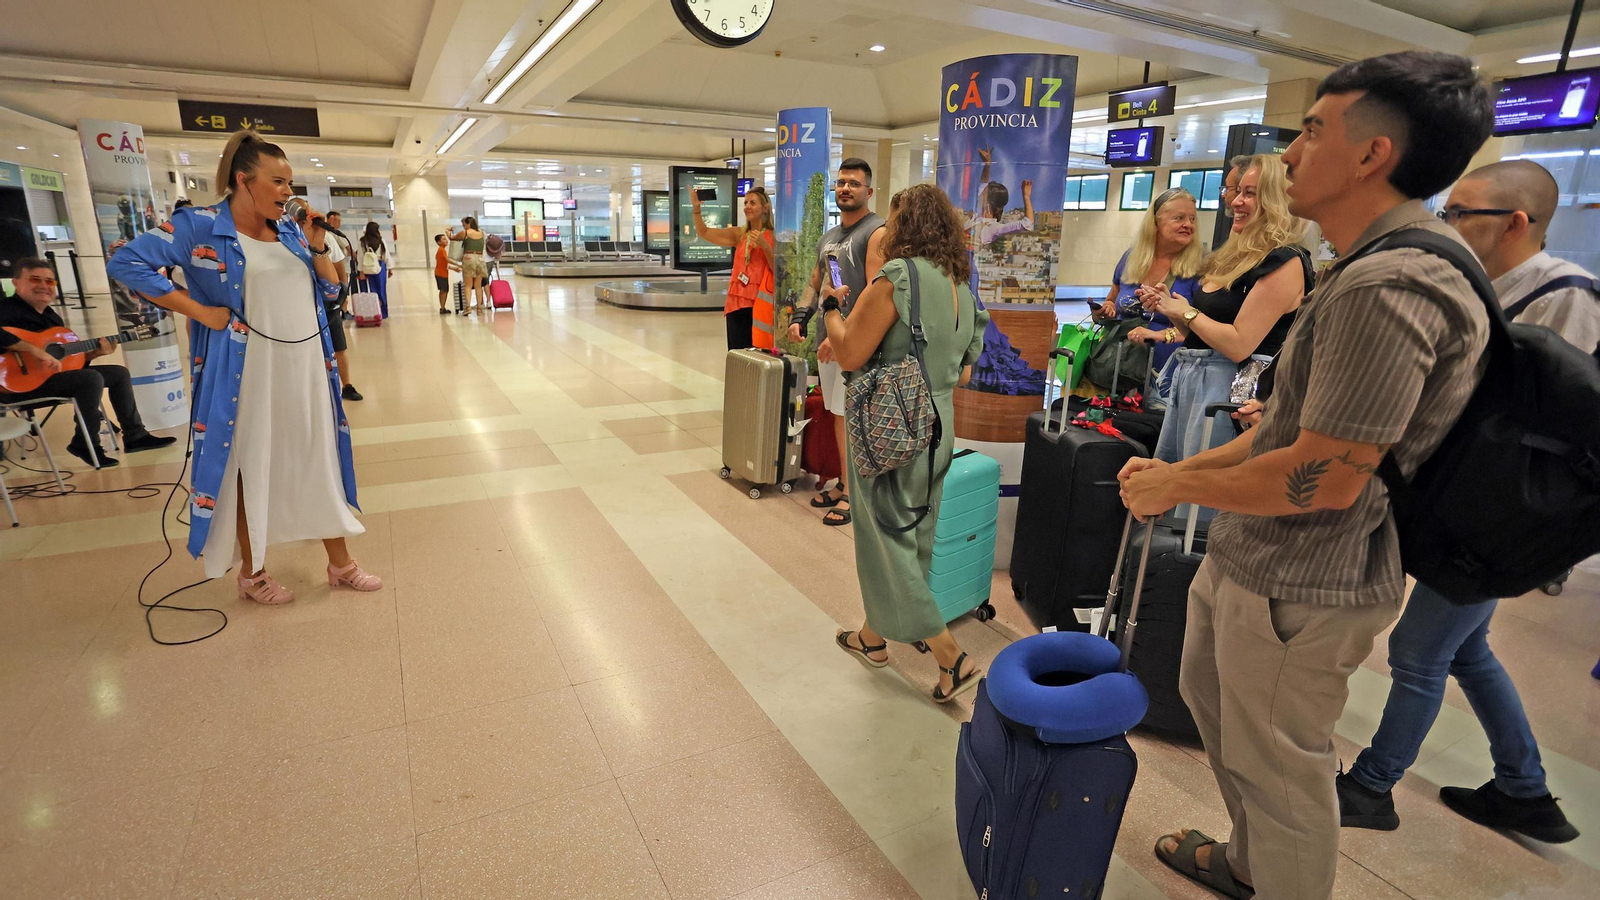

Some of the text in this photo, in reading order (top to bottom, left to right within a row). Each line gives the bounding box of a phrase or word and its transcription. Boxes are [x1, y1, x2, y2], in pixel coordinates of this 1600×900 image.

[704, 9, 711, 21] 7
[751, 5, 758, 16] 4
[721, 19, 728, 31] 6
[739, 16, 745, 28] 5
[946, 71, 1063, 113] CÁDIZ
[1132, 101, 1143, 109] Belt
[1132, 99, 1158, 117] Cinta 4
[954, 113, 1038, 131] PROVINCIA
[778, 122, 816, 146] DIZ
